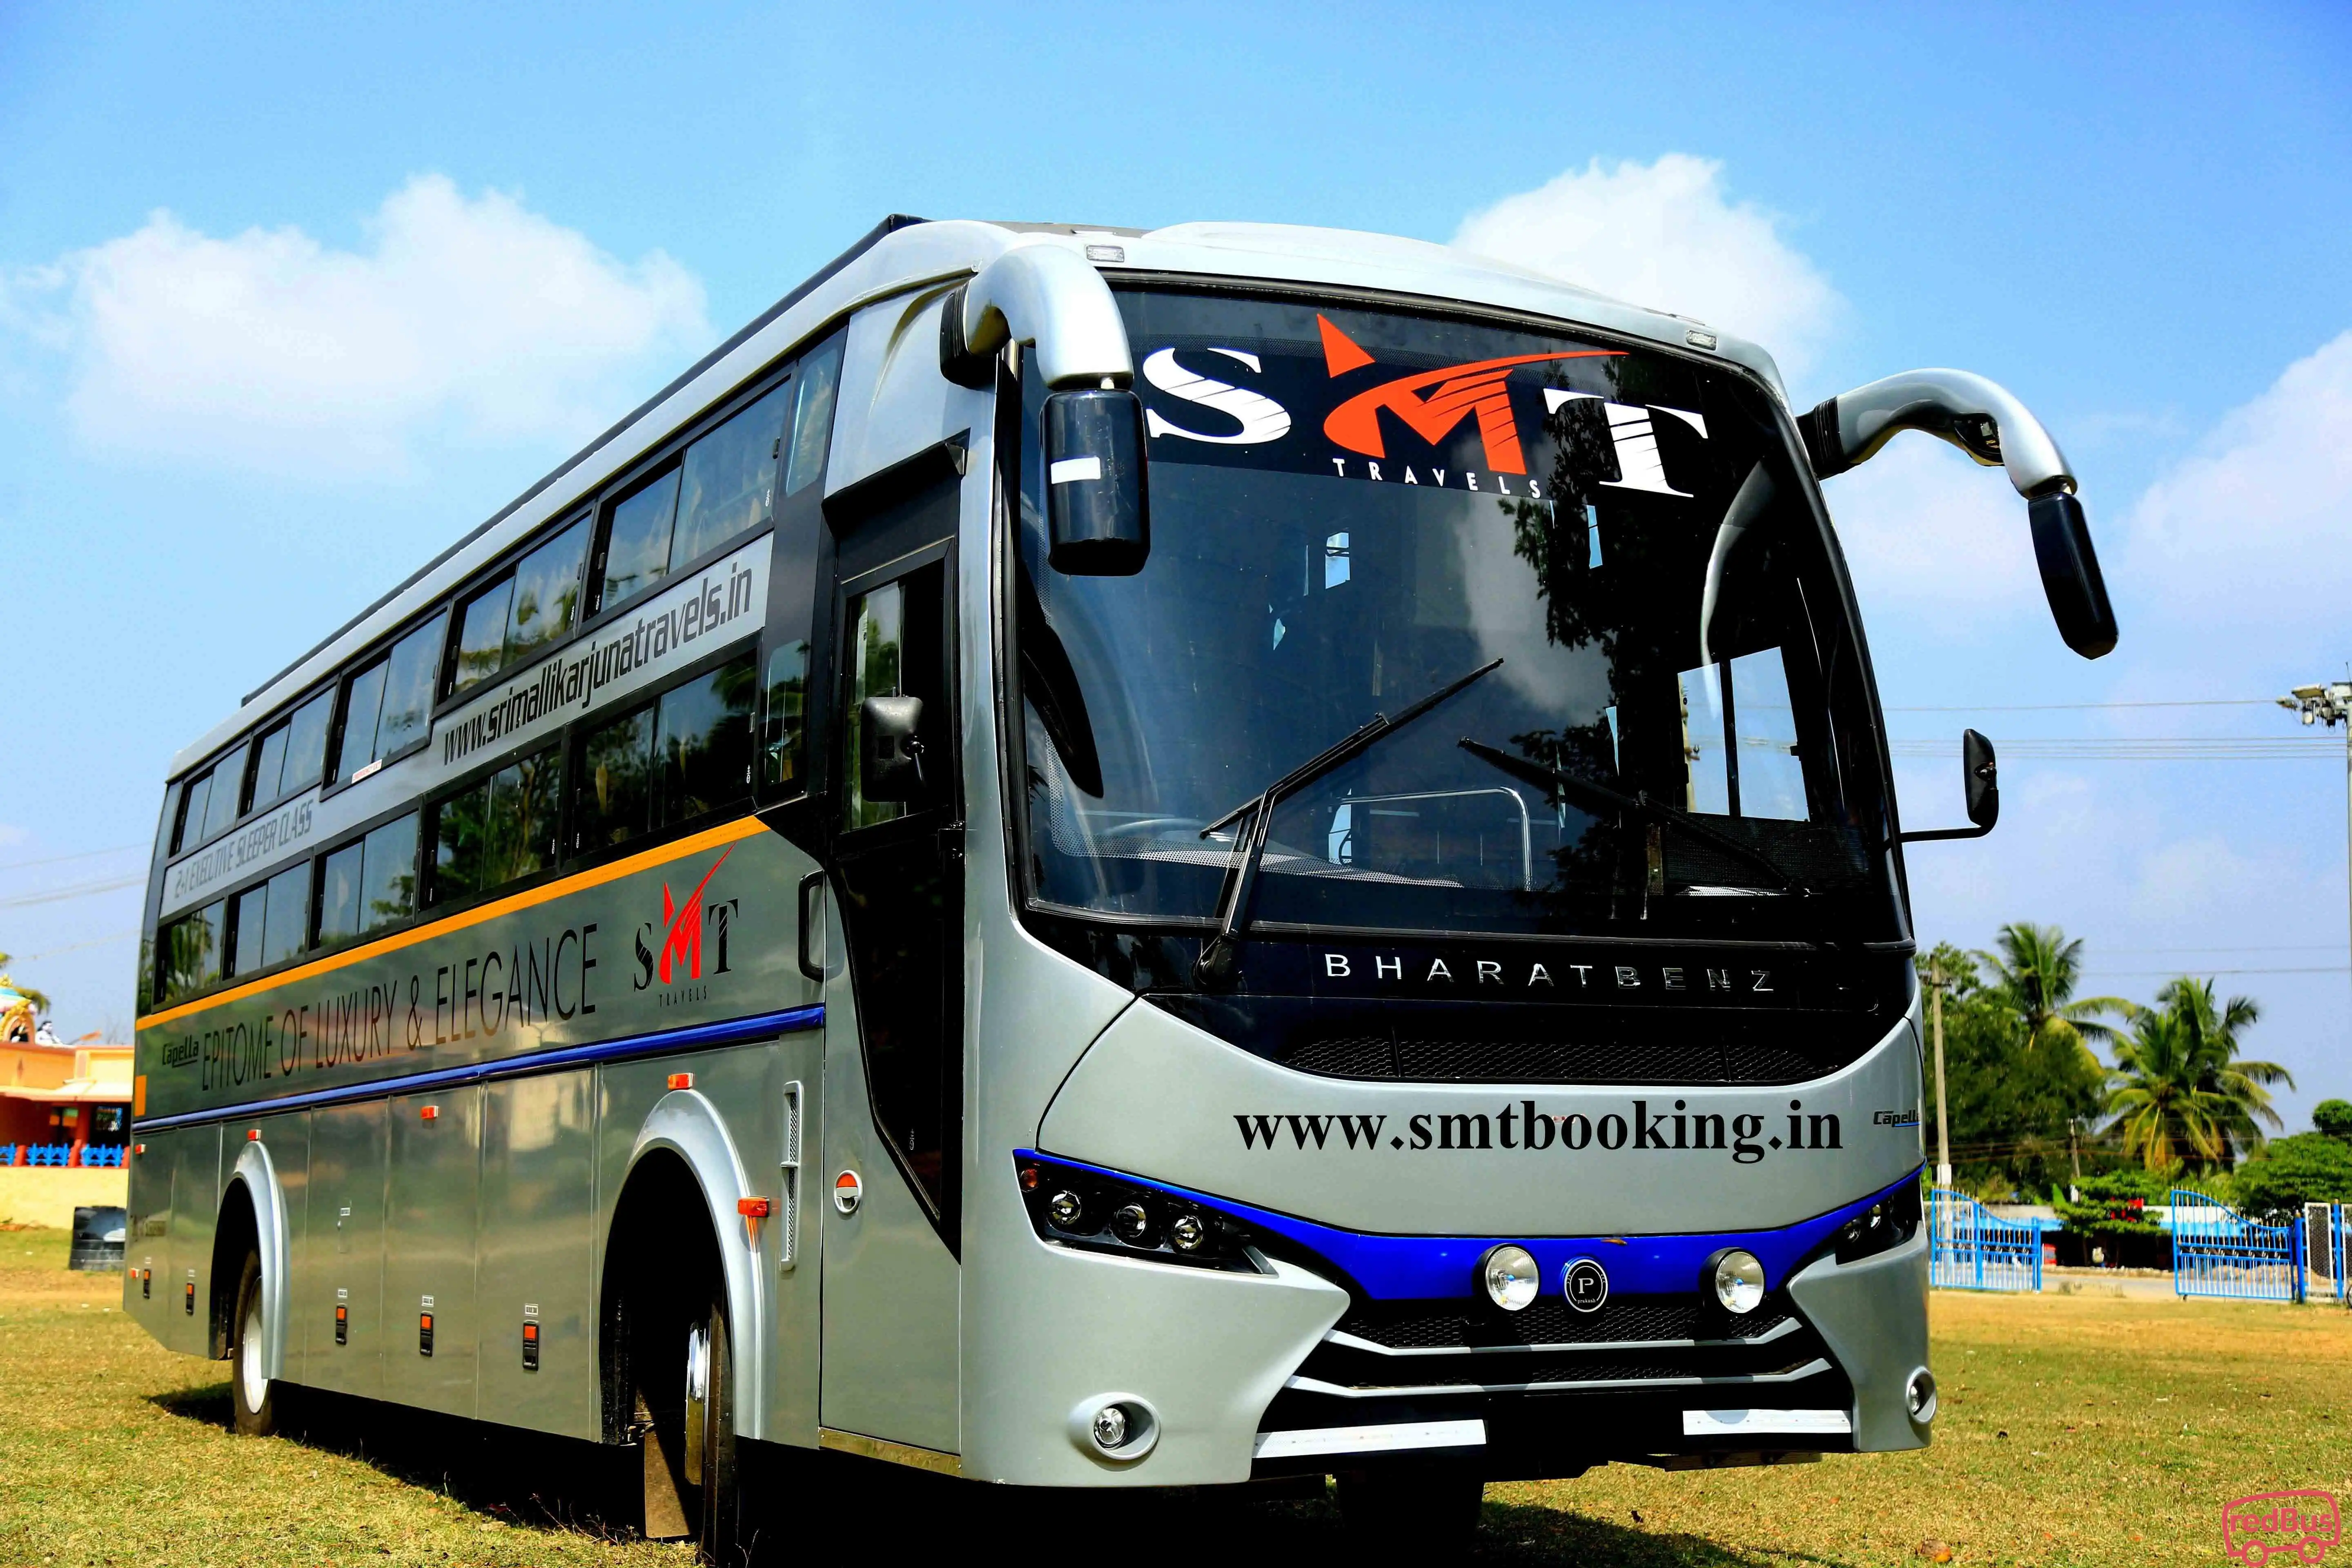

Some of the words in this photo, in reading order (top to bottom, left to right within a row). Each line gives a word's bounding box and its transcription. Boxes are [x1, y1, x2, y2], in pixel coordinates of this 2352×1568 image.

[1143, 313, 1709, 498] SMT
[1332, 458, 1541, 499] TRAVELS
[444, 562, 752, 766] www.srimallikarjunatravels.in
[236, 818, 278, 868] SLEEPER
[279, 798, 314, 846] CLASS
[634, 841, 739, 992] SMT
[659, 985, 707, 1008] TRAVELS
[1324, 953, 1774, 992] BHARATBENZ
[202, 1016, 274, 1091] EPITOME
[281, 1005, 309, 1077] OF
[316, 980, 397, 1069] LUXURY
[406, 975, 423, 1051] &
[435, 923, 598, 1045] ELEGANCE
[162, 1035, 199, 1068] Capella
[1578, 1278, 1594, 1294] P
